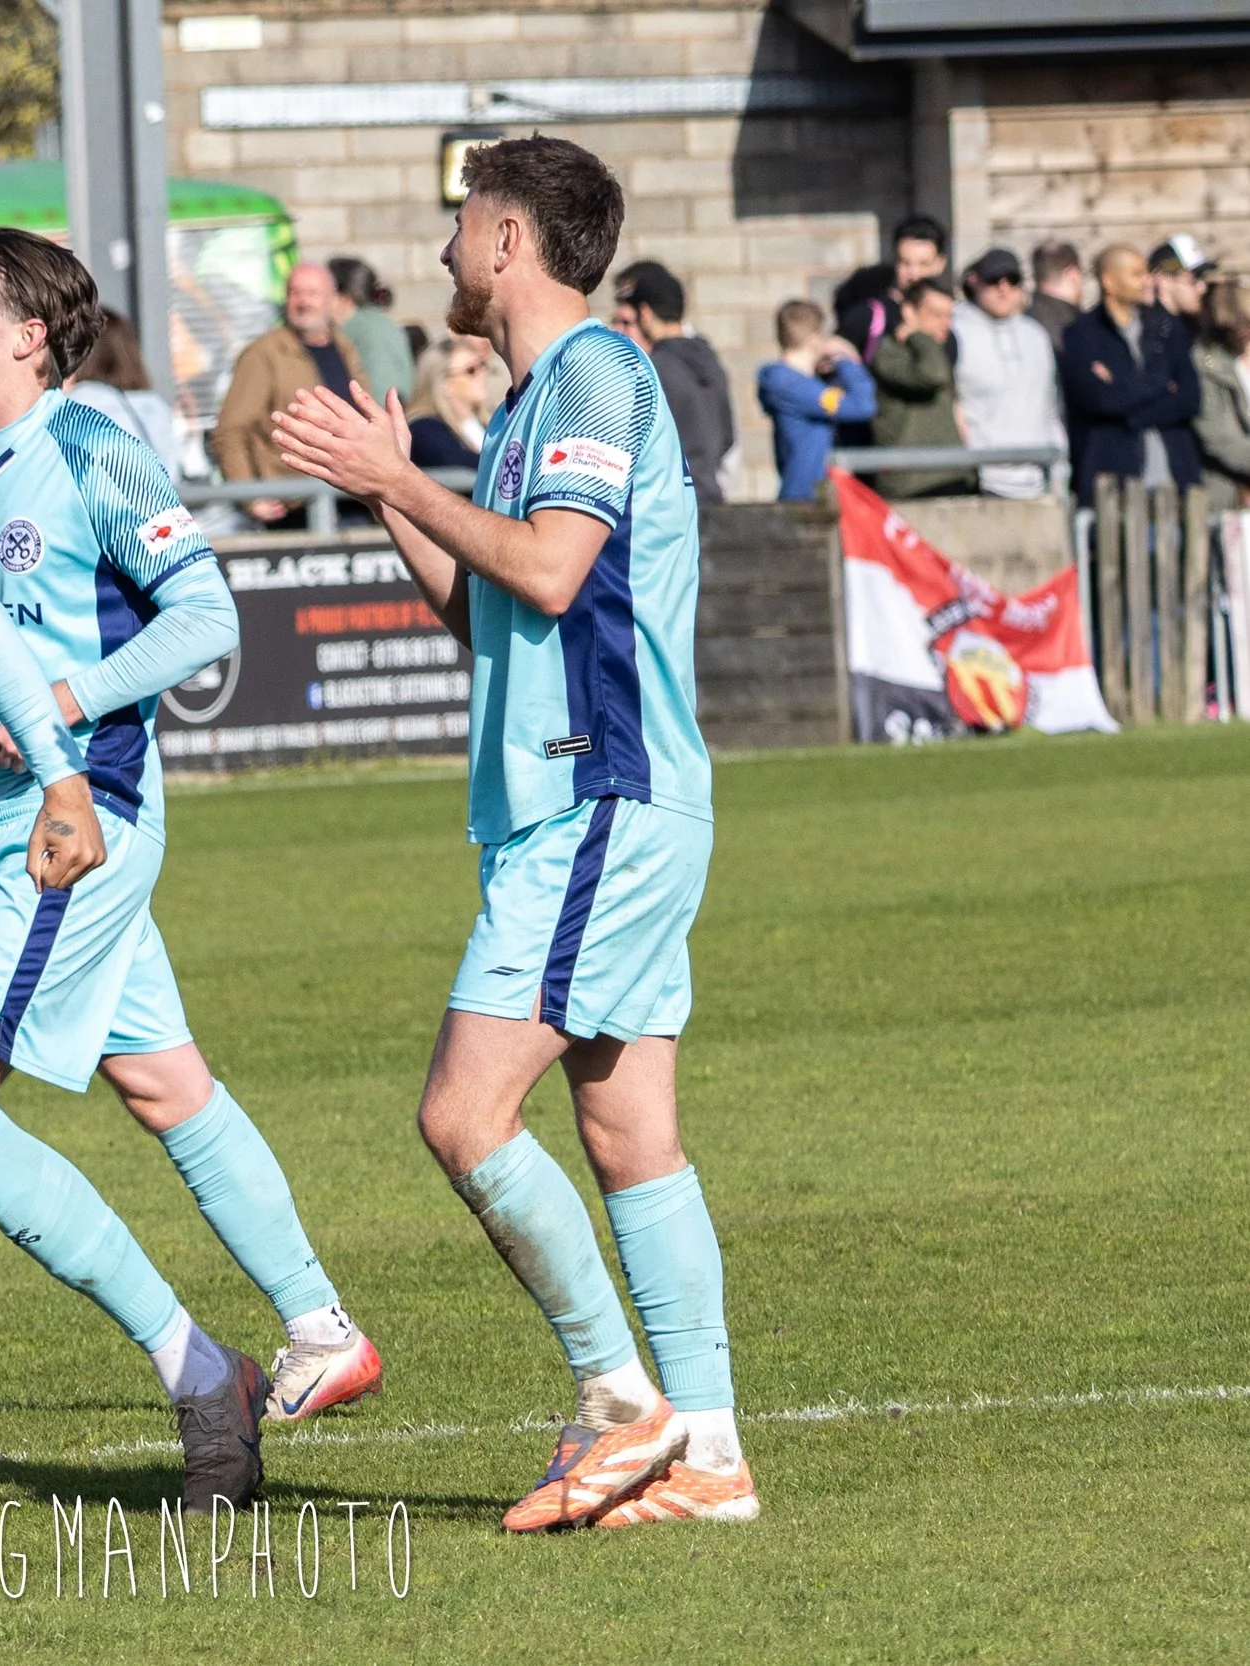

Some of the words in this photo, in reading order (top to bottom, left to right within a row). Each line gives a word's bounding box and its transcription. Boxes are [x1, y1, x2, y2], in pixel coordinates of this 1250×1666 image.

[576, 444, 605, 457] Midlands
[572, 458, 601, 470] Charity
[587, 452, 624, 472] Ambulance
[565, 493, 596, 506] PITMEN
[181, 557, 195, 568] THE
[226, 552, 350, 592] BLACK
